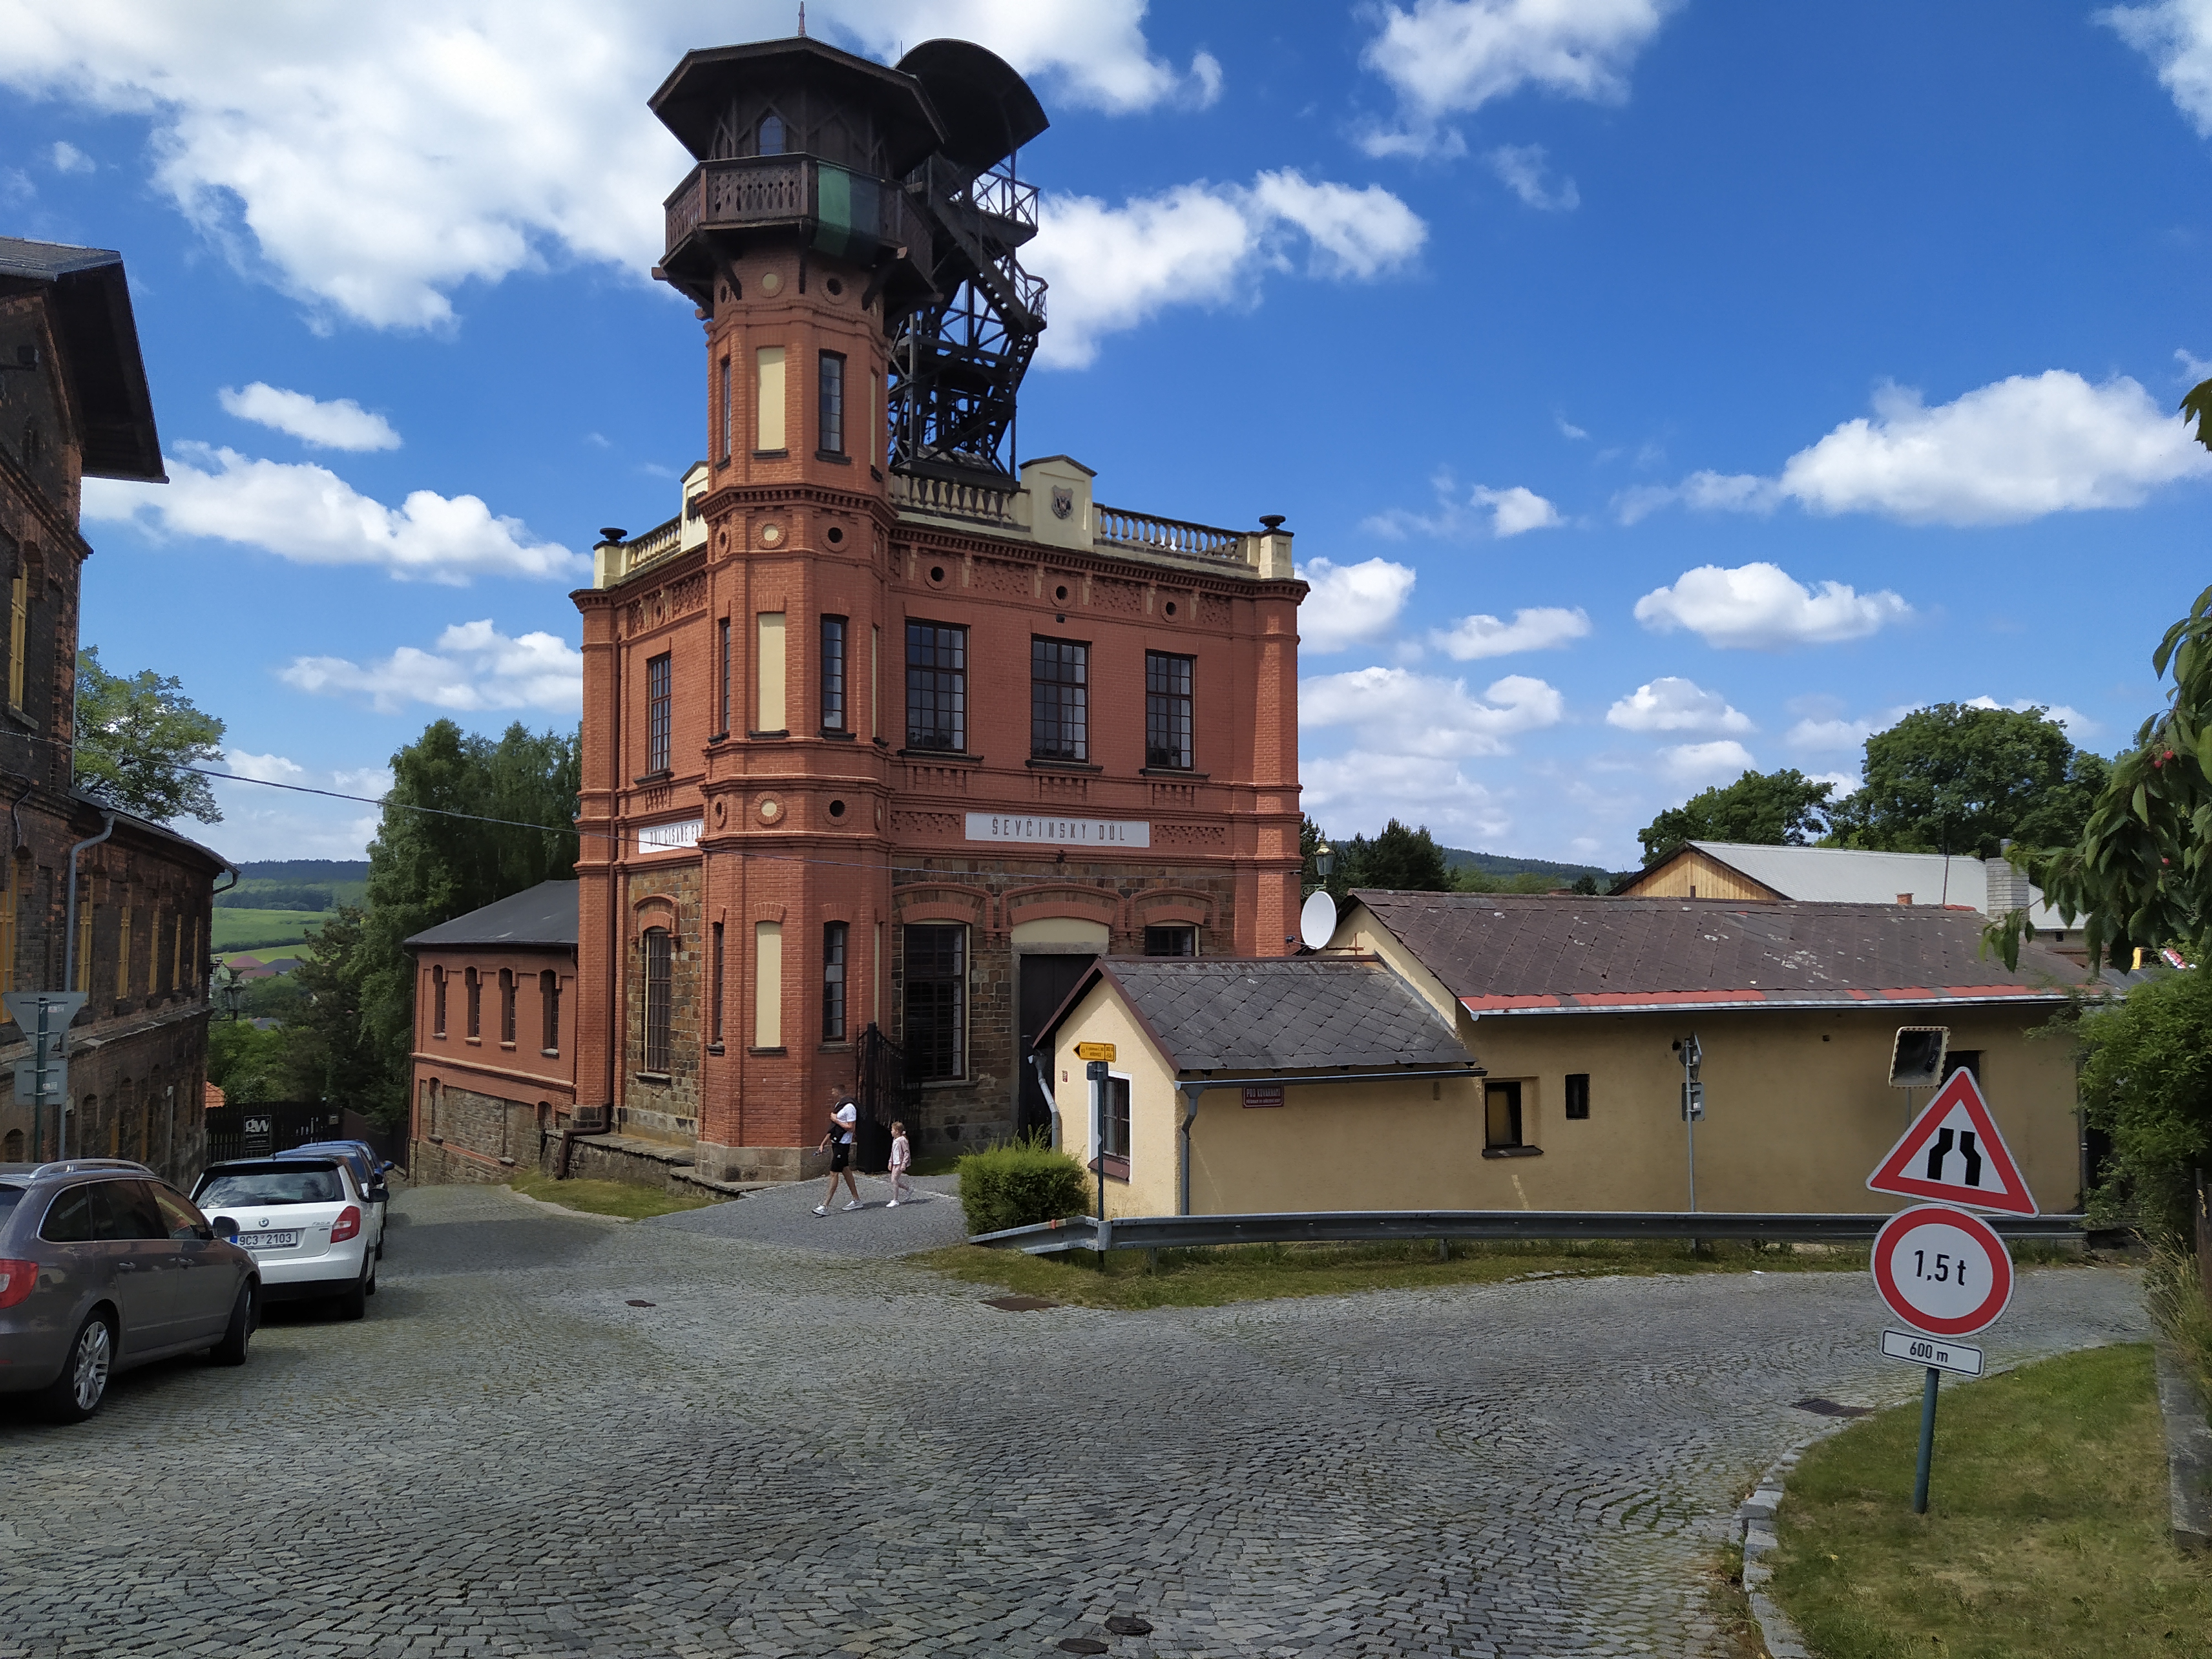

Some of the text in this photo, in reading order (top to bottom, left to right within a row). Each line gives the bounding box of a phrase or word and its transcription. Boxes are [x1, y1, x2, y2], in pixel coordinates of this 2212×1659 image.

[992, 816, 1125, 841] ŠEVČÍNSKÝ DŮL
[239, 1233, 292, 1246] 9C3 2103
[1914, 1250, 1966, 1286] 1,5 t
[1910, 1341, 1949, 1363] 600 m
